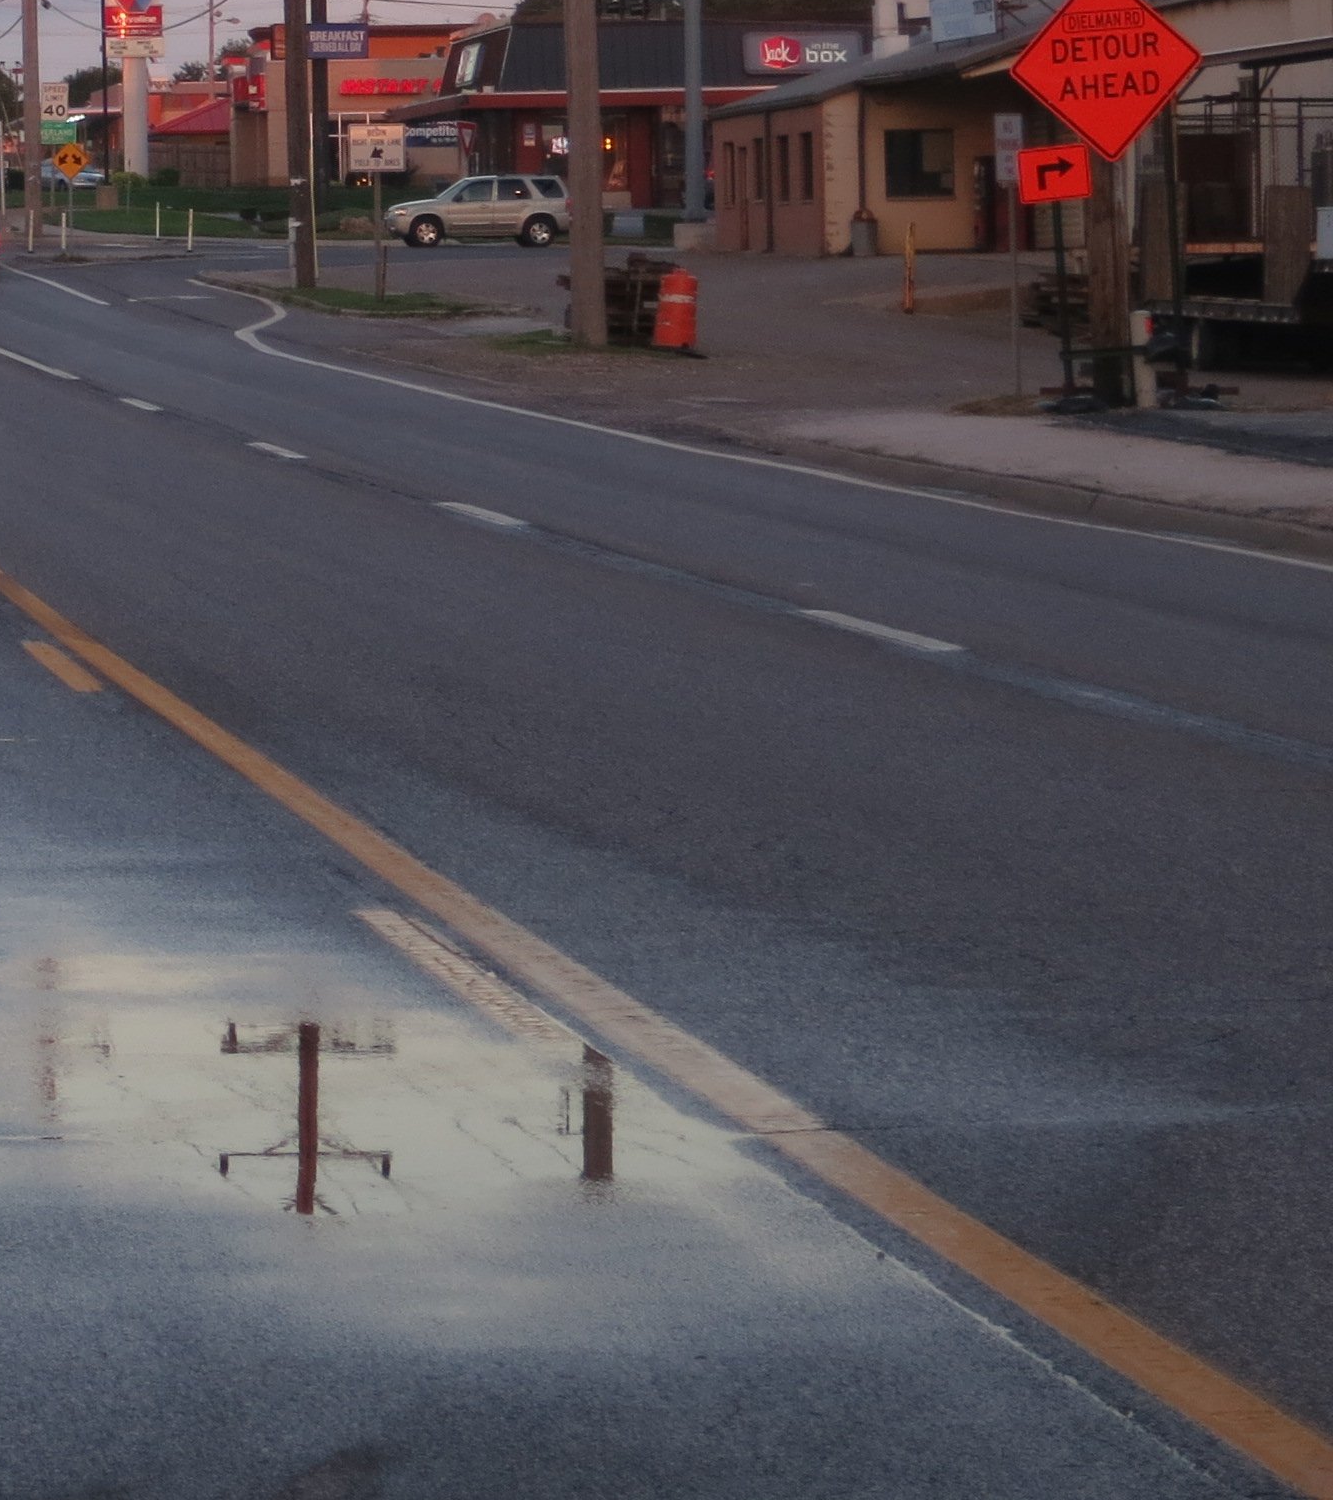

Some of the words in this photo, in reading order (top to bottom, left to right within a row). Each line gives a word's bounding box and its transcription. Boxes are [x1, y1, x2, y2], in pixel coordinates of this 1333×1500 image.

[1068, 11, 1121, 30] DIELMAN
[1124, 11, 1140, 25] RD
[309, 31, 365, 41] BREAKFAST
[764, 40, 799, 63] Jack
[805, 47, 848, 63] box
[1051, 31, 1160, 64] DETOUR
[1059, 70, 1160, 101] AHEAD
[44, 104, 66, 116] 40
